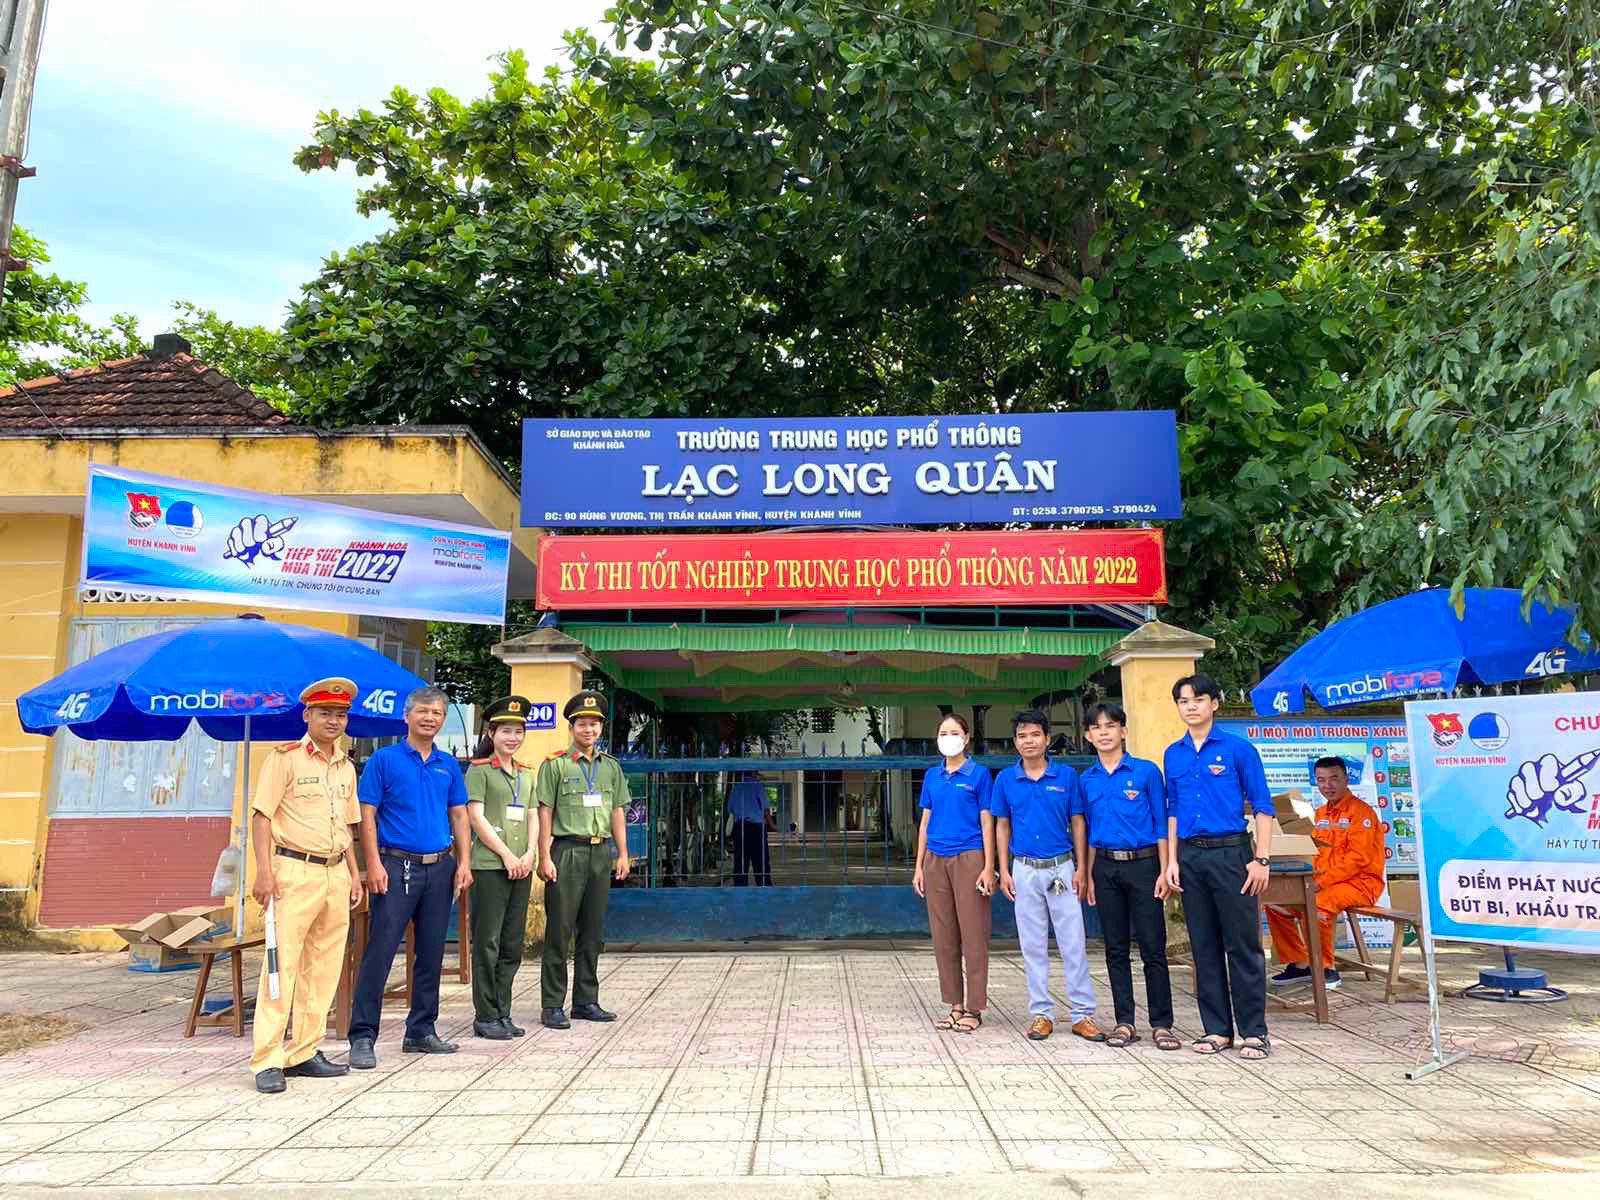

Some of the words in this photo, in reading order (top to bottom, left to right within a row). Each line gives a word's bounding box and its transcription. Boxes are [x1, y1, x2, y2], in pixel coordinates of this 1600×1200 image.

[545, 427, 559, 439] SỞ
[560, 428, 580, 438] GIÁO
[582, 429, 600, 440] DỤC
[601, 428, 613, 438] VÀ
[614, 428, 633, 438] ĐÀO
[634, 429, 651, 440] TẠO
[573, 440, 605, 449] KHÁNH
[607, 440, 625, 449] HÒA
[677, 427, 760, 450] TRƯỜNG
[769, 430, 838, 450] TRUNG
[846, 428, 888, 452] HỌC
[896, 420, 938, 447] PHỔ
[948, 422, 1021, 447] THÔNG
[641, 463, 740, 504] LẠC
[762, 462, 892, 496] LONG
[915, 451, 1058, 496] QUÂN
[544, 511, 562, 521] ĐC:
[564, 511, 577, 520] 90
[579, 509, 607, 521] HÙNG
[610, 511, 647, 521] VƯƠNG,
[648, 511, 665, 523] THỊ
[668, 508, 695, 520] TRẤN
[697, 509, 733, 520] KHÁNH
[764, 510, 797, 521] HUYỆN
[800, 509, 835, 519] KHÁNH
[838, 508, 862, 519] VĨNH
[1112, 504, 1157, 514] 3790424
[127, 536, 151, 548] HUYỆN
[154, 539, 178, 551] KHÁNH
[349, 540, 386, 549] KHÁNH
[281, 560, 310, 575] MÙA
[313, 562, 335, 577] THI
[285, 545, 315, 561] TIẾP
[315, 545, 343, 562] SỨC
[336, 551, 400, 581] 2022
[559, 551, 591, 591] KỲ
[594, 561, 633, 591] THI
[638, 548, 680, 590] TỐT
[686, 551, 769, 597] NGHIỆP
[774, 558, 849, 589] TRUNG
[855, 557, 901, 596] HỌC
[907, 542, 952, 587] PHỔ
[957, 547, 1034, 587] THÔNG
[1040, 547, 1089, 586] NĂM
[1093, 555, 1138, 585] 2022
[1524, 647, 1568, 676] 4G
[1326, 671, 1442, 699] mobifone
[57, 692, 90, 720] 4G
[150, 688, 287, 711] mobifone
[362, 688, 397, 714] 4G
[1272, 690, 1289, 713] 4G
[1263, 723, 1289, 739] MỘT
[1320, 723, 1369, 738] TRƯỜNG
[1373, 725, 1408, 738] XANH
[1435, 755, 1459, 766] HUYỆN
[1460, 754, 1487, 765] KHÁNH
[1458, 869, 1501, 890] ĐIỂM
[1507, 874, 1556, 892] PHÁT
[1450, 896, 1481, 913] BÚT
[1487, 900, 1509, 917] BI,
[1516, 896, 1569, 918] KHẨU
[1575, 905, 1600, 920] TR
